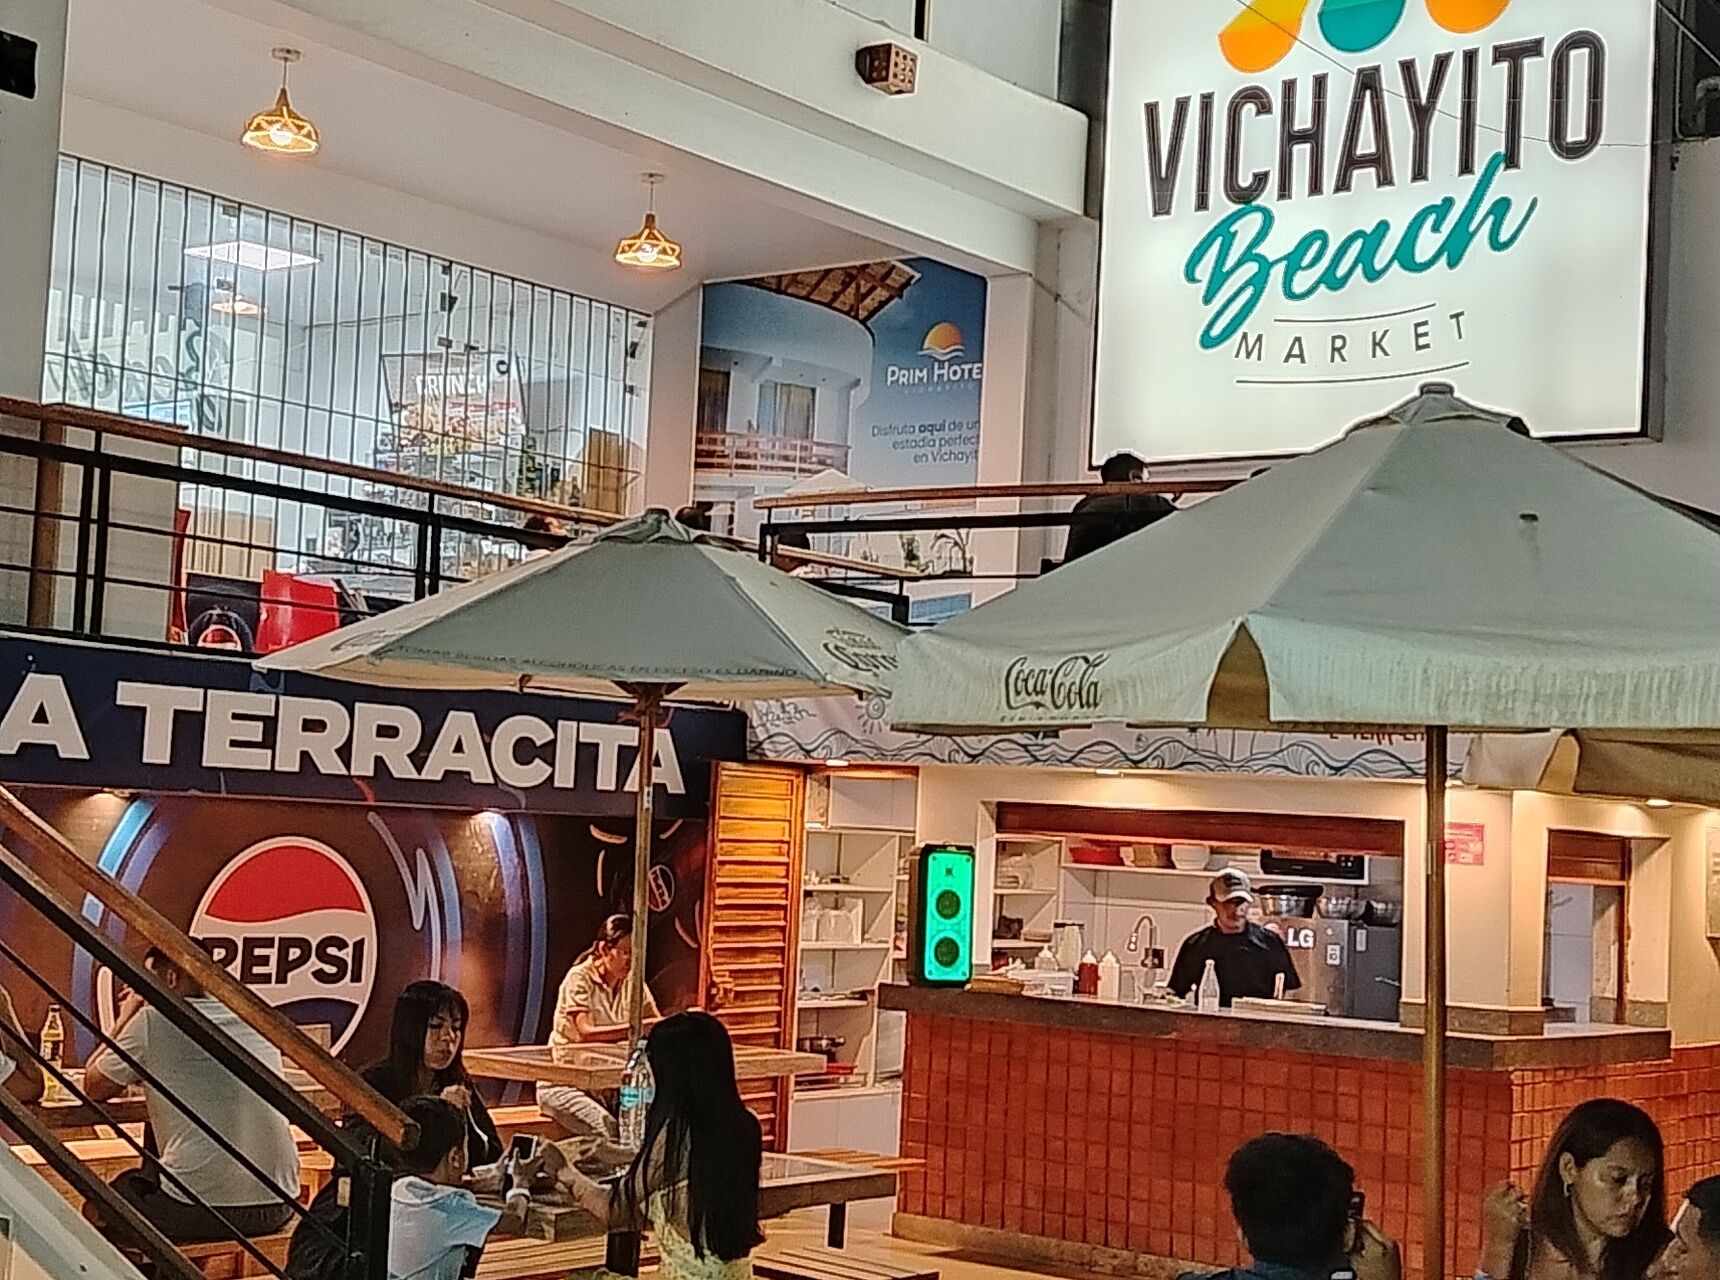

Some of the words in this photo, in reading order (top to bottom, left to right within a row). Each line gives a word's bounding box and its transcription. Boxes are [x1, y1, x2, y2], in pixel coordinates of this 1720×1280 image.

[1144, 29, 1607, 217] VICHAYITO
[1184, 151, 1539, 350] Beach
[1234, 311, 1466, 365] MARKET
[886, 365, 928, 387] PRIM
[871, 423, 916, 437] Disfruta
[948, 420, 964, 432] de
[914, 452, 928, 463] en
[115, 681, 687, 795] TERRACITA
[201, 935, 366, 986] PEPSI
[1286, 927, 1315, 949] LG
